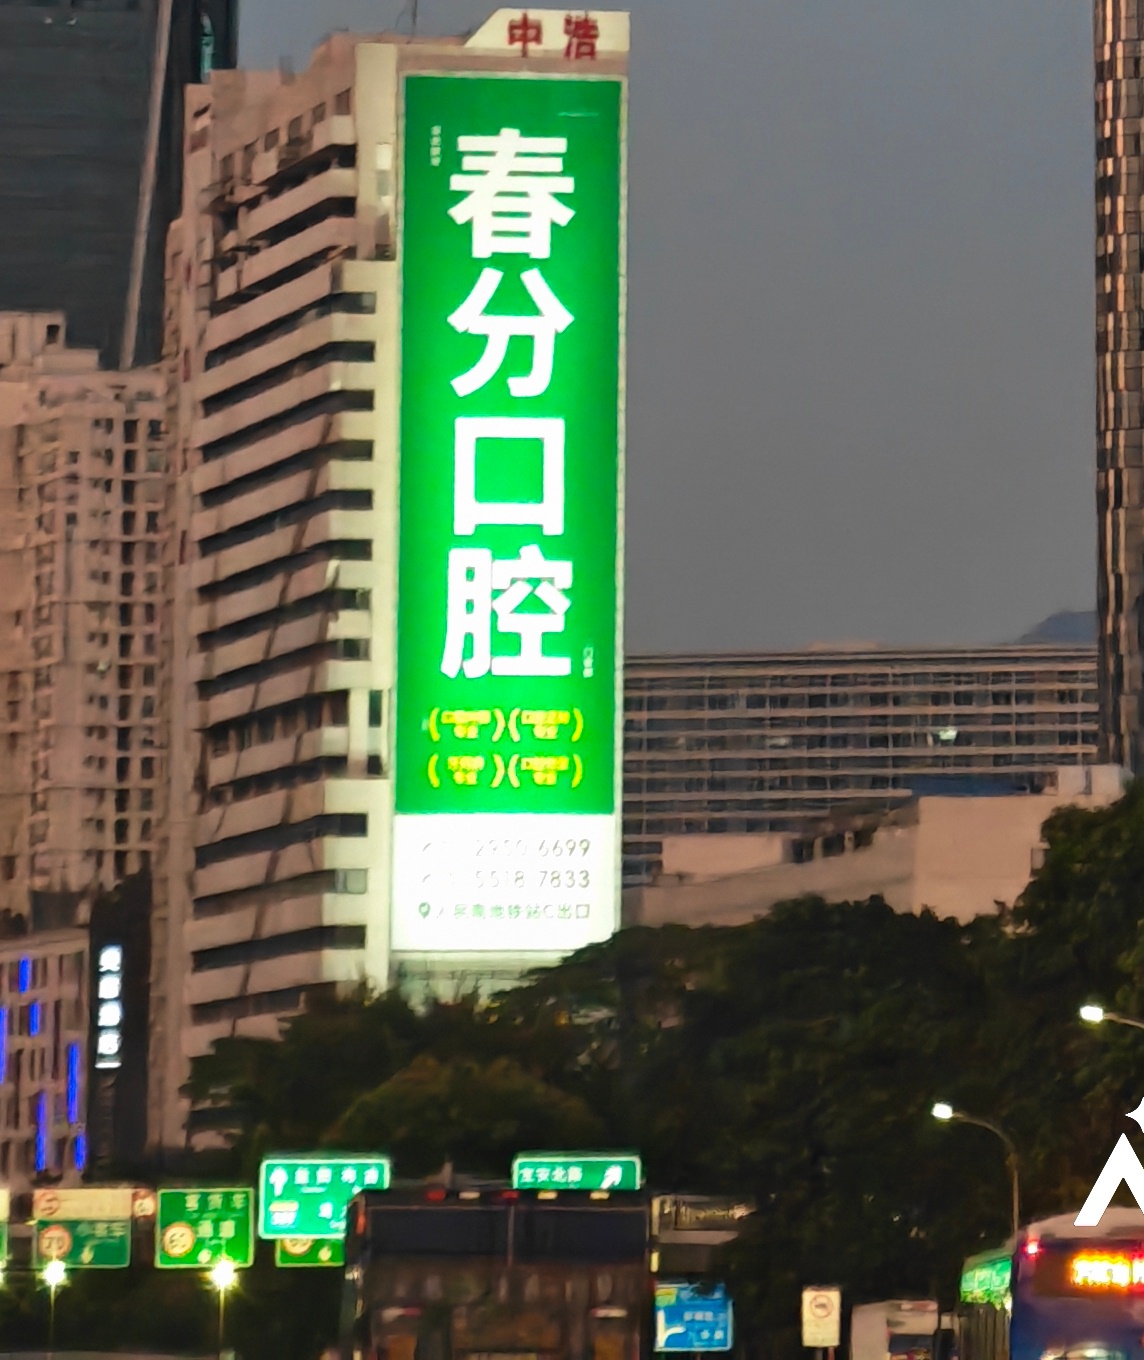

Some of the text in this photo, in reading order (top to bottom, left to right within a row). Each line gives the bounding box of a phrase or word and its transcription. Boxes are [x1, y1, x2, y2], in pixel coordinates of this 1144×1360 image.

[507, 11, 600, 60] 中浩
[440, 128, 576, 678] 春分口腔
[538, 838, 592, 857] 6699
[538, 869, 591, 889] 7833
